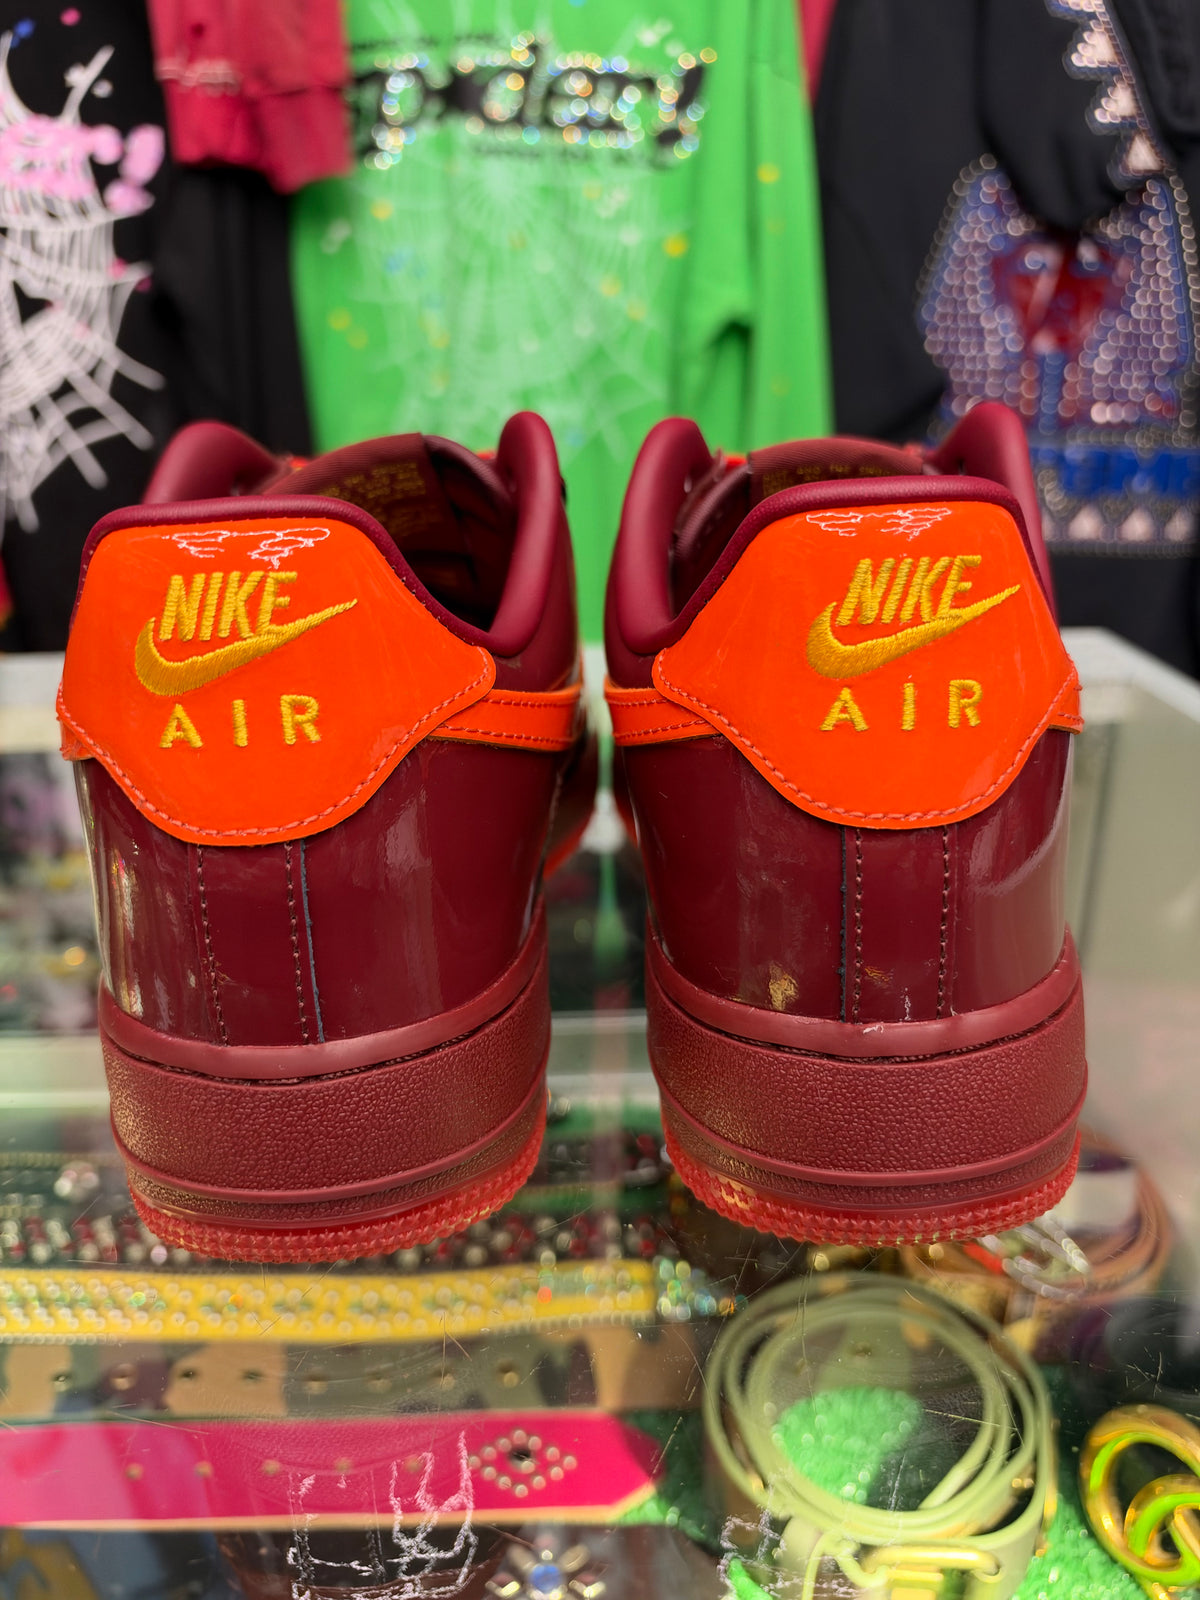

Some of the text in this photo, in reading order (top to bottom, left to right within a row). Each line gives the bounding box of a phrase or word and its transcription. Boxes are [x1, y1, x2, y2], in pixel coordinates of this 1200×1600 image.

[158, 570, 298, 641] NIKE
[836, 554, 982, 626] NIKE
[159, 694, 322, 748] AIR
[820, 679, 983, 731] AIR
